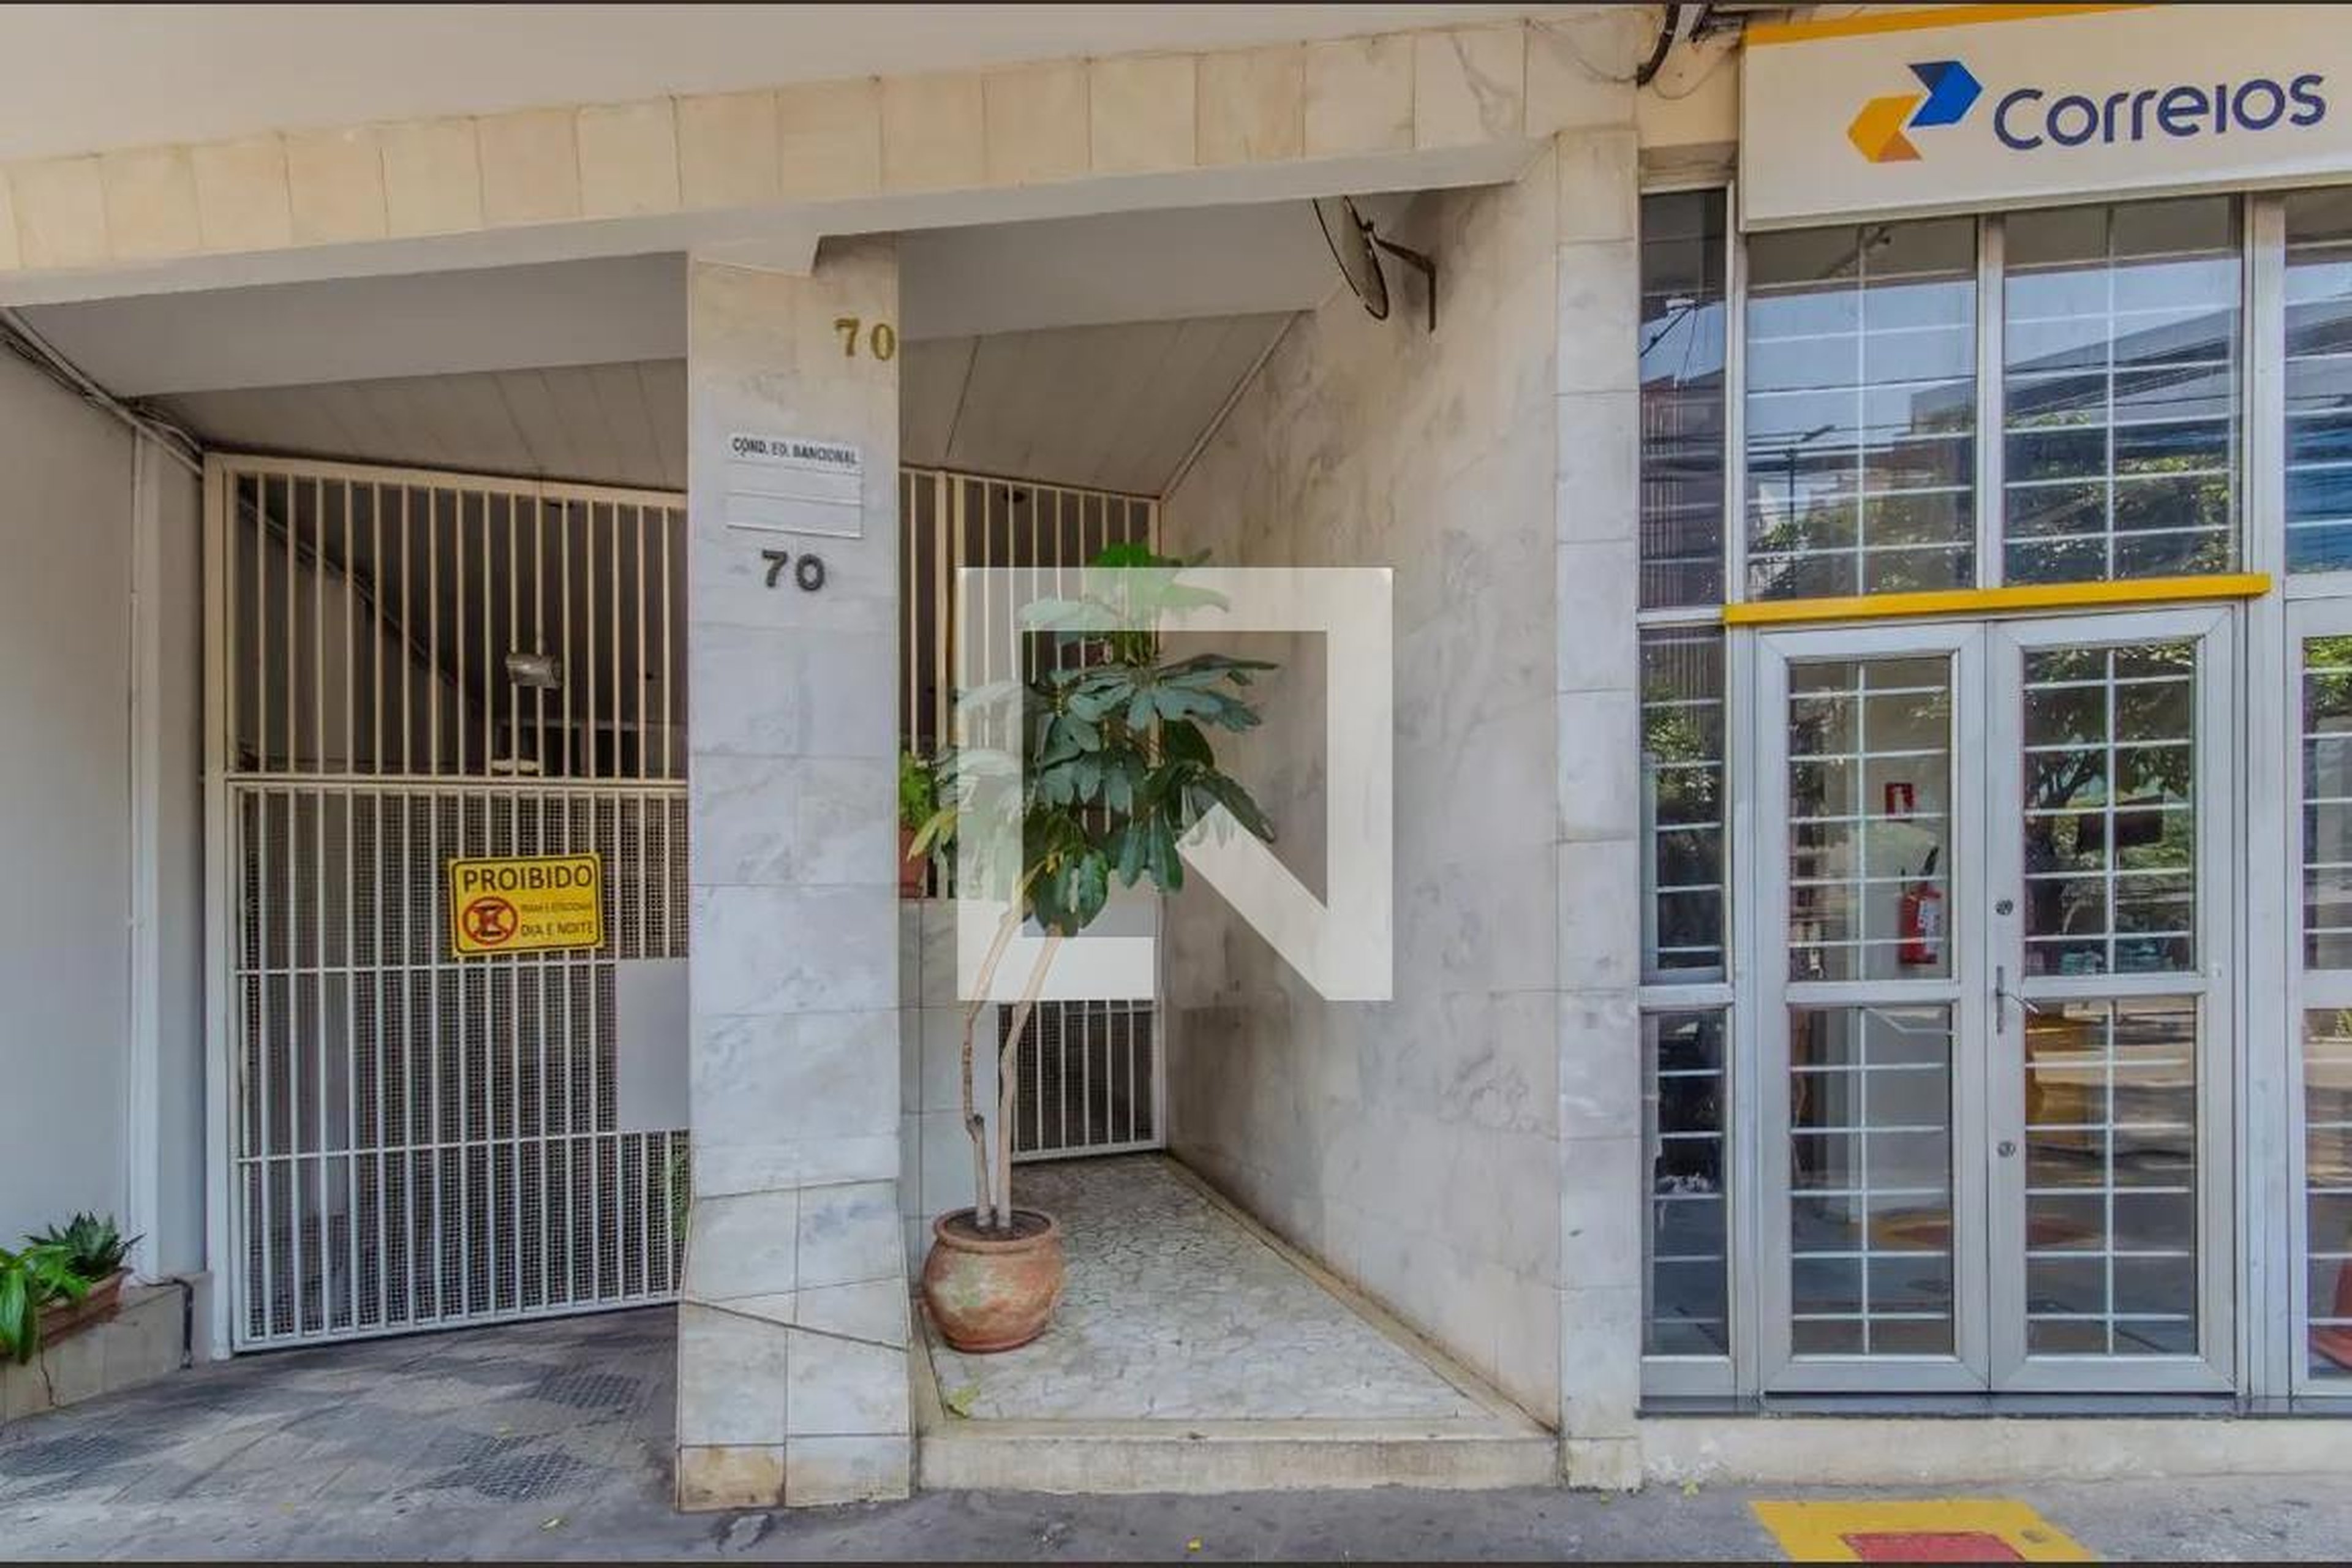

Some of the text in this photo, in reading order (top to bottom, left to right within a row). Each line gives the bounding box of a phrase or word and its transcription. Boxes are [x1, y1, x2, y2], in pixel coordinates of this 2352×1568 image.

[1994, 74, 2327, 151] Correios
[833, 317, 895, 361] 70
[761, 549, 825, 592] 70
[464, 864, 593, 892] PROIBIDO
